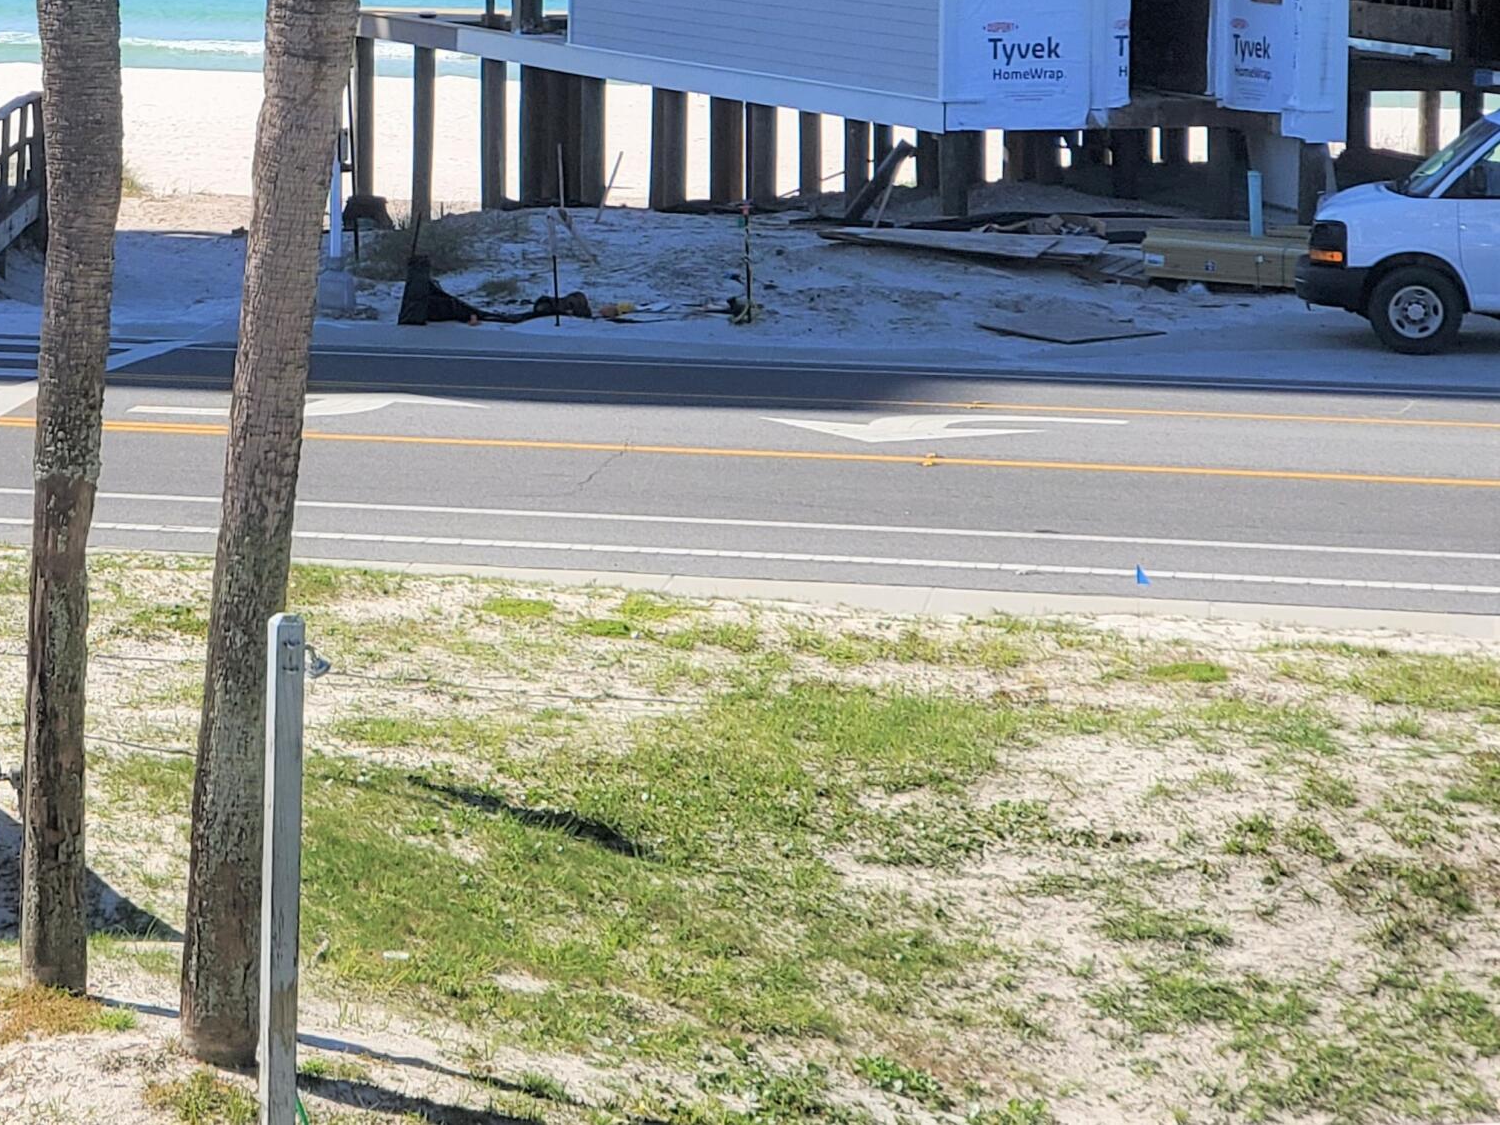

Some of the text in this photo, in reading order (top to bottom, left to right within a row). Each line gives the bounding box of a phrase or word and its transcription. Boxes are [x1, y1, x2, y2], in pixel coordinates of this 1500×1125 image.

[988, 36, 1060, 66] Tyvek
[1233, 34, 1271, 63] Tyvek
[993, 67, 1064, 81] HomeWrap
